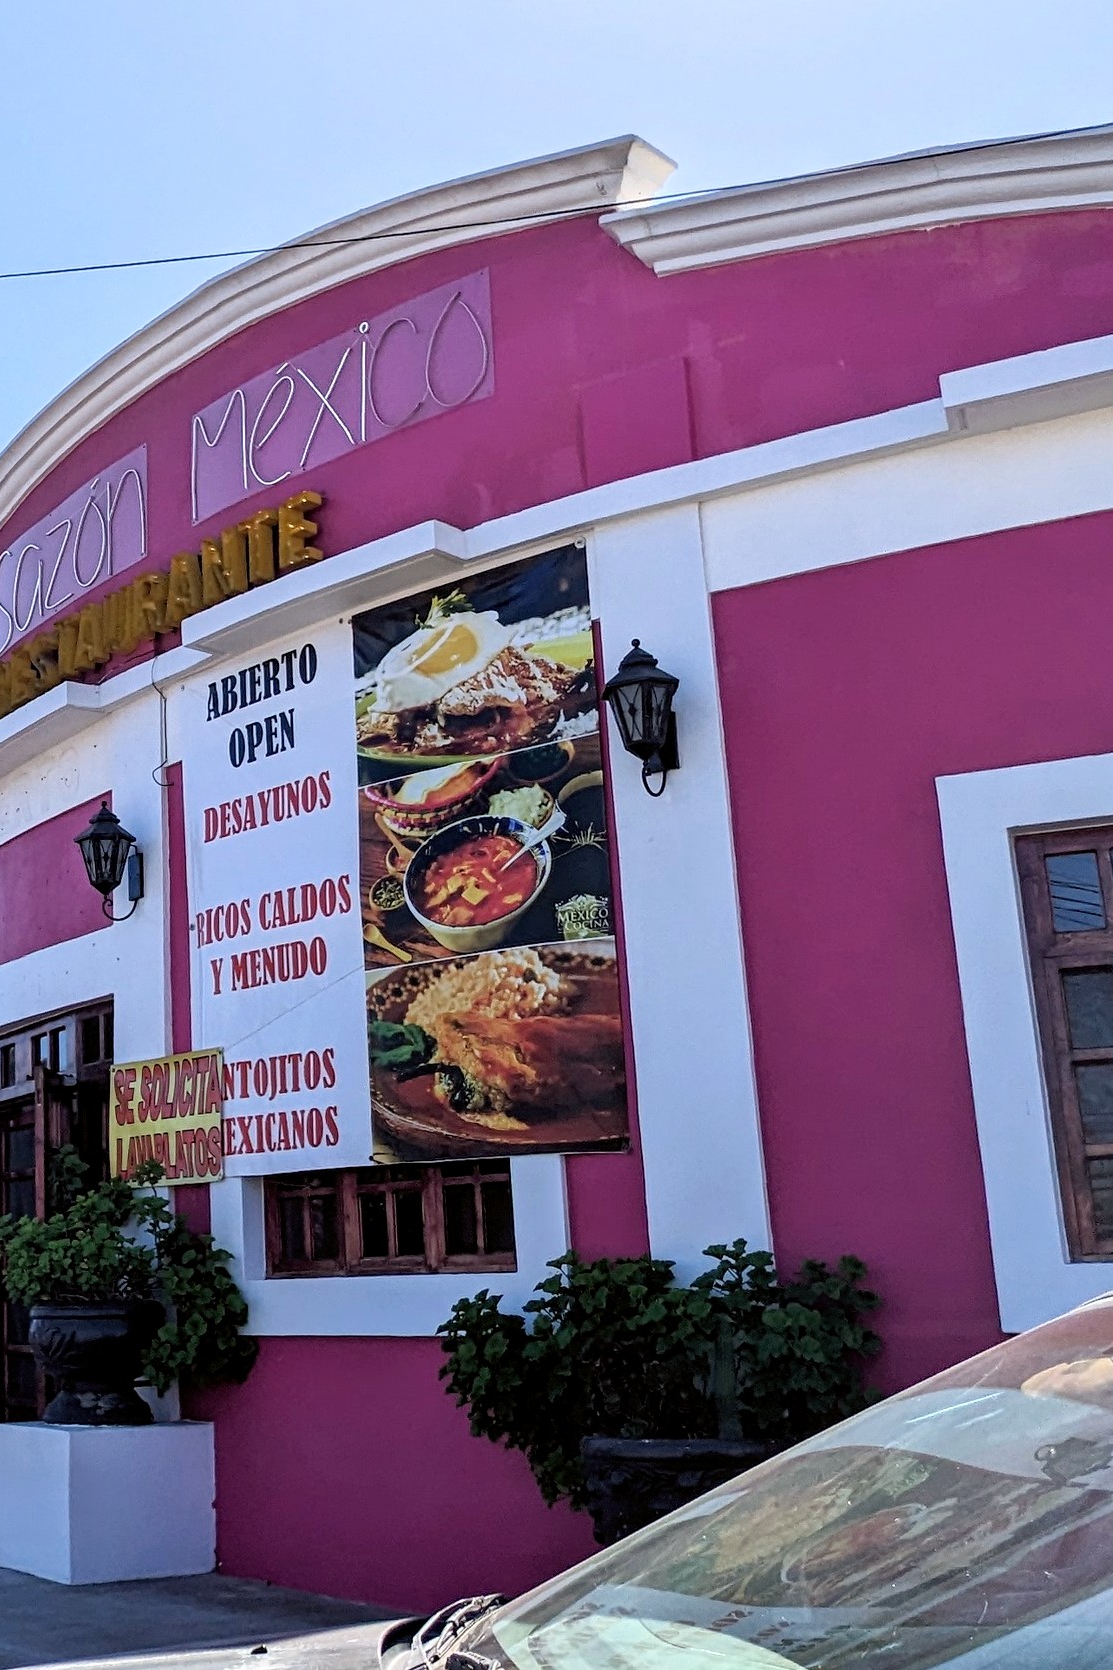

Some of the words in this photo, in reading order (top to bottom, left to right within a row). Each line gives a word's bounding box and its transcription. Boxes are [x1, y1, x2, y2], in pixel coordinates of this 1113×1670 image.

[205, 643, 318, 723] ABIERTO
[228, 707, 296, 768] OPEN
[203, 771, 332, 843] DESAYUNOS
[195, 897, 252, 949] RICOS
[258, 874, 352, 931] CALDOS
[210, 957, 224, 995] Y
[231, 936, 328, 992] MENUDO
[113, 1068, 137, 1126] SE
[137, 1054, 221, 1123] SOLICITA
[221, 1047, 337, 1101] NTOJITOS
[221, 1105, 340, 1157] EXICANOS
